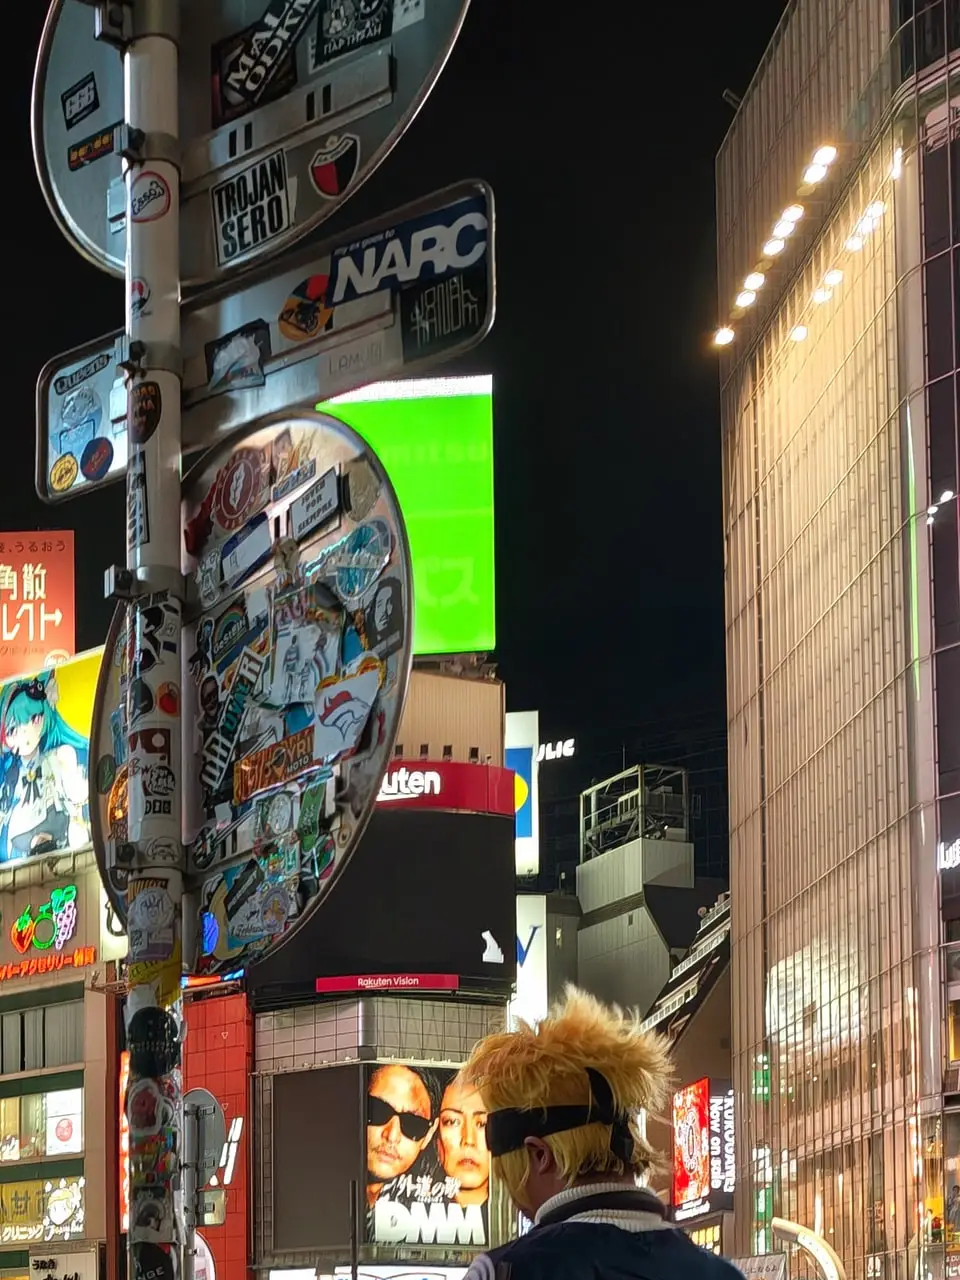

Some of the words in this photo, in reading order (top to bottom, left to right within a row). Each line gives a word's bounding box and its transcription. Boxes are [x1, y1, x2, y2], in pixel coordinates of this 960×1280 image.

[215, 156, 284, 223] TROJAN
[221, 196, 284, 259] SERO
[331, 212, 488, 304] NARC
[357, 976, 391, 989] Rakuten
[393, 974, 419, 987] Vision
[711, 1136, 722, 1156] on
[394, 1174, 462, 1201] 外道の歌
[375, 1199, 486, 1245] DMM
